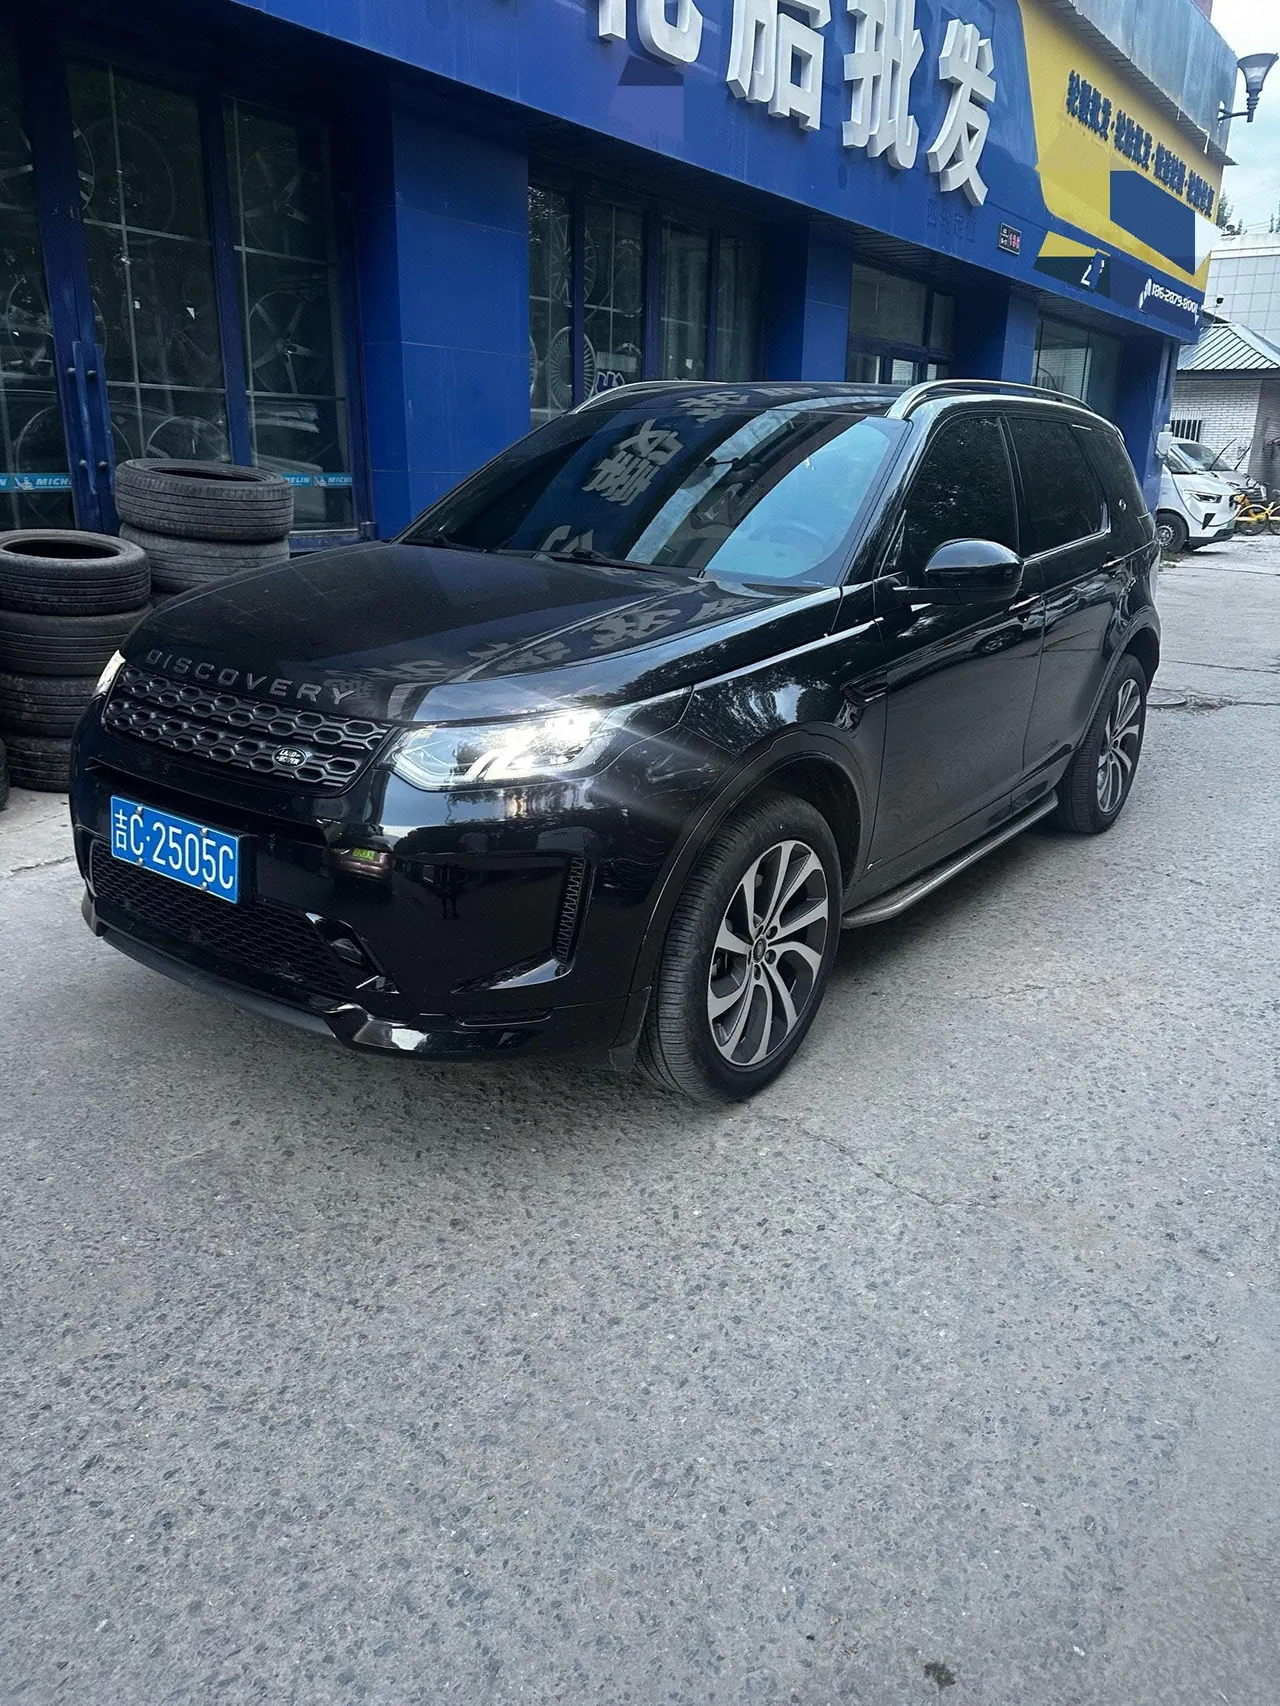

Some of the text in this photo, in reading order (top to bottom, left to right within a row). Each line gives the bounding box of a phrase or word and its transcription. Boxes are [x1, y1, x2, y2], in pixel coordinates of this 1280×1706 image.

[36, 478, 71, 486] MICH
[146, 649, 356, 705] DISCOVERY
[279, 750, 298, 758] LAND
[278, 756, 300, 765] ROVER
